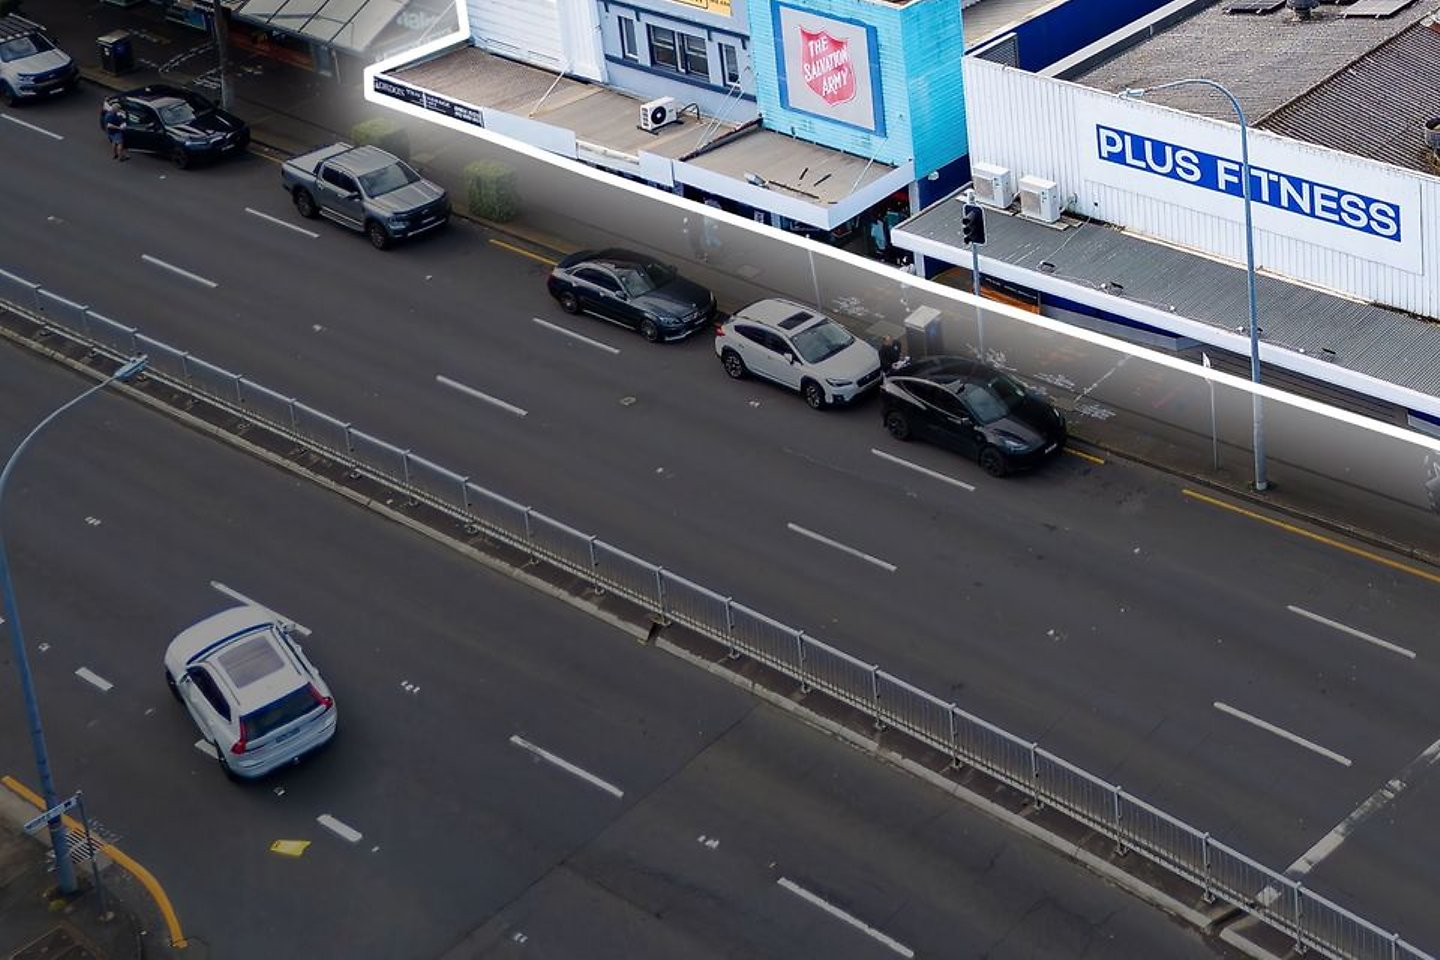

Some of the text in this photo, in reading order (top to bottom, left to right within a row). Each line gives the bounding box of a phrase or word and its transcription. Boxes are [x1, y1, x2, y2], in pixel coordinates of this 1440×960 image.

[803, 44, 849, 82] SALVATION
[808, 35, 829, 59] THE
[822, 66, 849, 97] ARMY
[1101, 128, 1201, 183] PLUS
